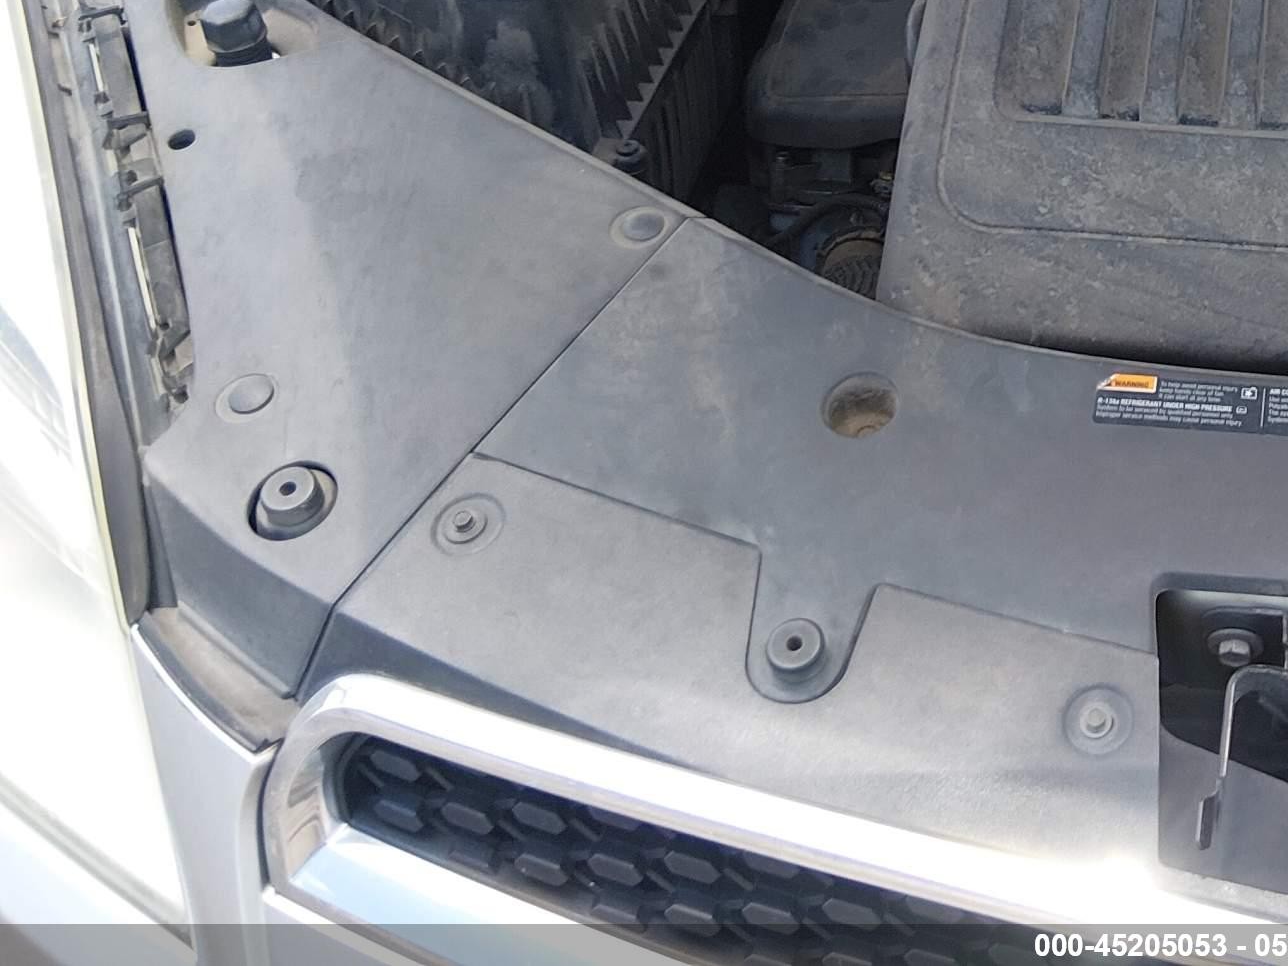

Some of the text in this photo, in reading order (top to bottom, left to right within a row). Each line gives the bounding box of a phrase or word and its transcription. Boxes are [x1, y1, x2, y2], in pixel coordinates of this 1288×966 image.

[1121, 399, 1162, 407] REFRIGERANT
[1163, 401, 1184, 409] UNDER
[1201, 404, 1233, 412] PRESSURE
